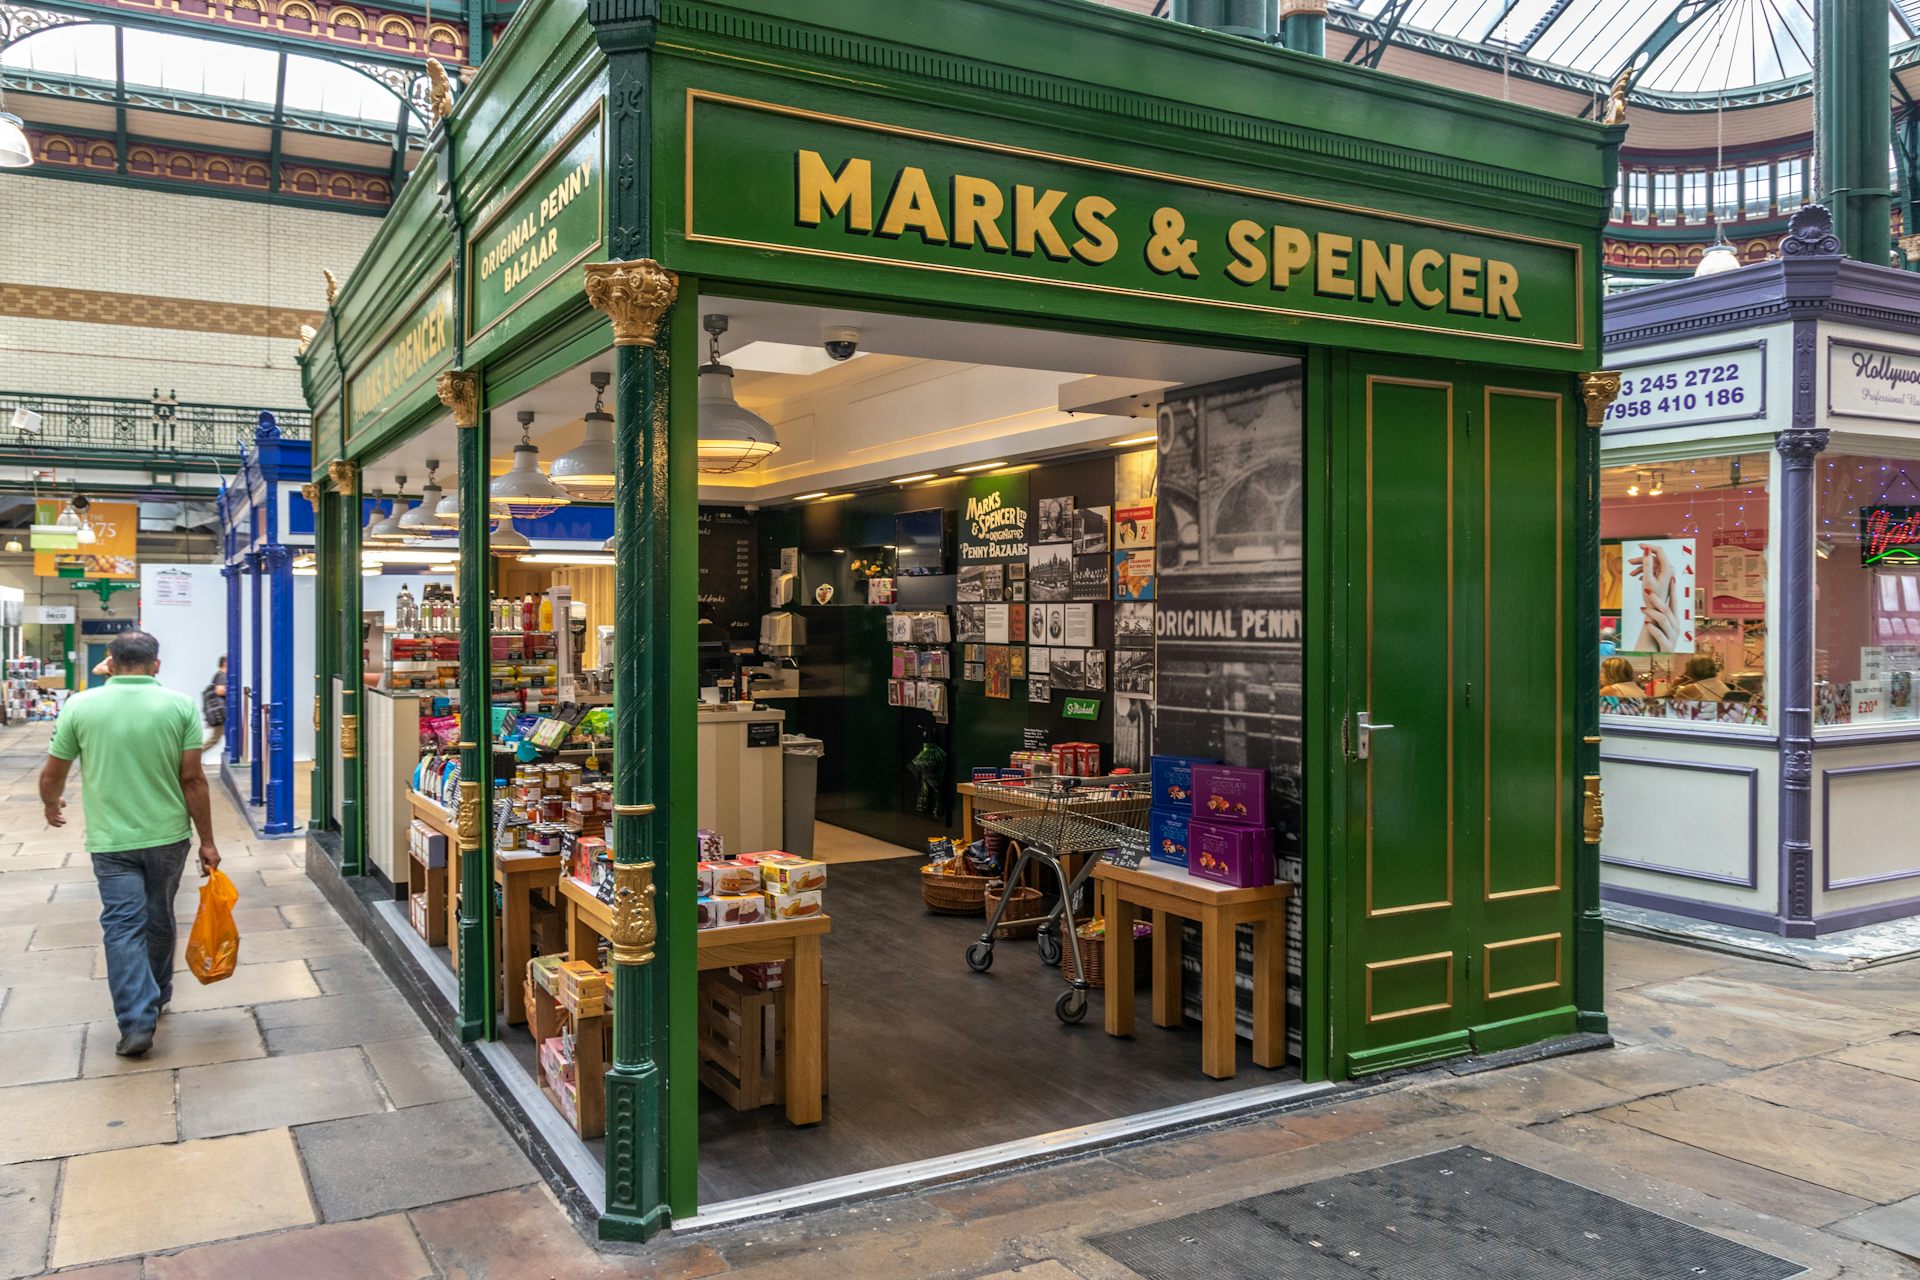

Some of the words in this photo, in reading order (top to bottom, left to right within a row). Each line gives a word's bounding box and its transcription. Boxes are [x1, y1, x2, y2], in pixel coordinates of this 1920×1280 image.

[481, 211, 537, 280] ORIGINAL
[540, 154, 592, 228] PENNY
[795, 149, 1119, 265] MARKS
[1144, 206, 1200, 279] &
[1224, 219, 1522, 321] SPENCER
[504, 227, 558, 293] BAZAAR
[354, 366, 382, 423] MARKS
[393, 301, 446, 392] SPENCER
[1640, 373, 1677, 393] 245
[1685, 364, 1739, 387] 2722
[1852, 352, 1920, 390] Hollywo
[1605, 399, 1651, 420] 7958
[1658, 393, 1697, 412] 410
[1705, 386, 1745, 407] 186
[978, 507, 1016, 539] SPENCER
[1866, 510, 1920, 555] Nail
[962, 543, 989, 559] PENNY
[989, 542, 1028, 557] BAZAARS
[1682, 545, 1694, 642] NAILS
[1157, 611, 1236, 637] ORIGINAL
